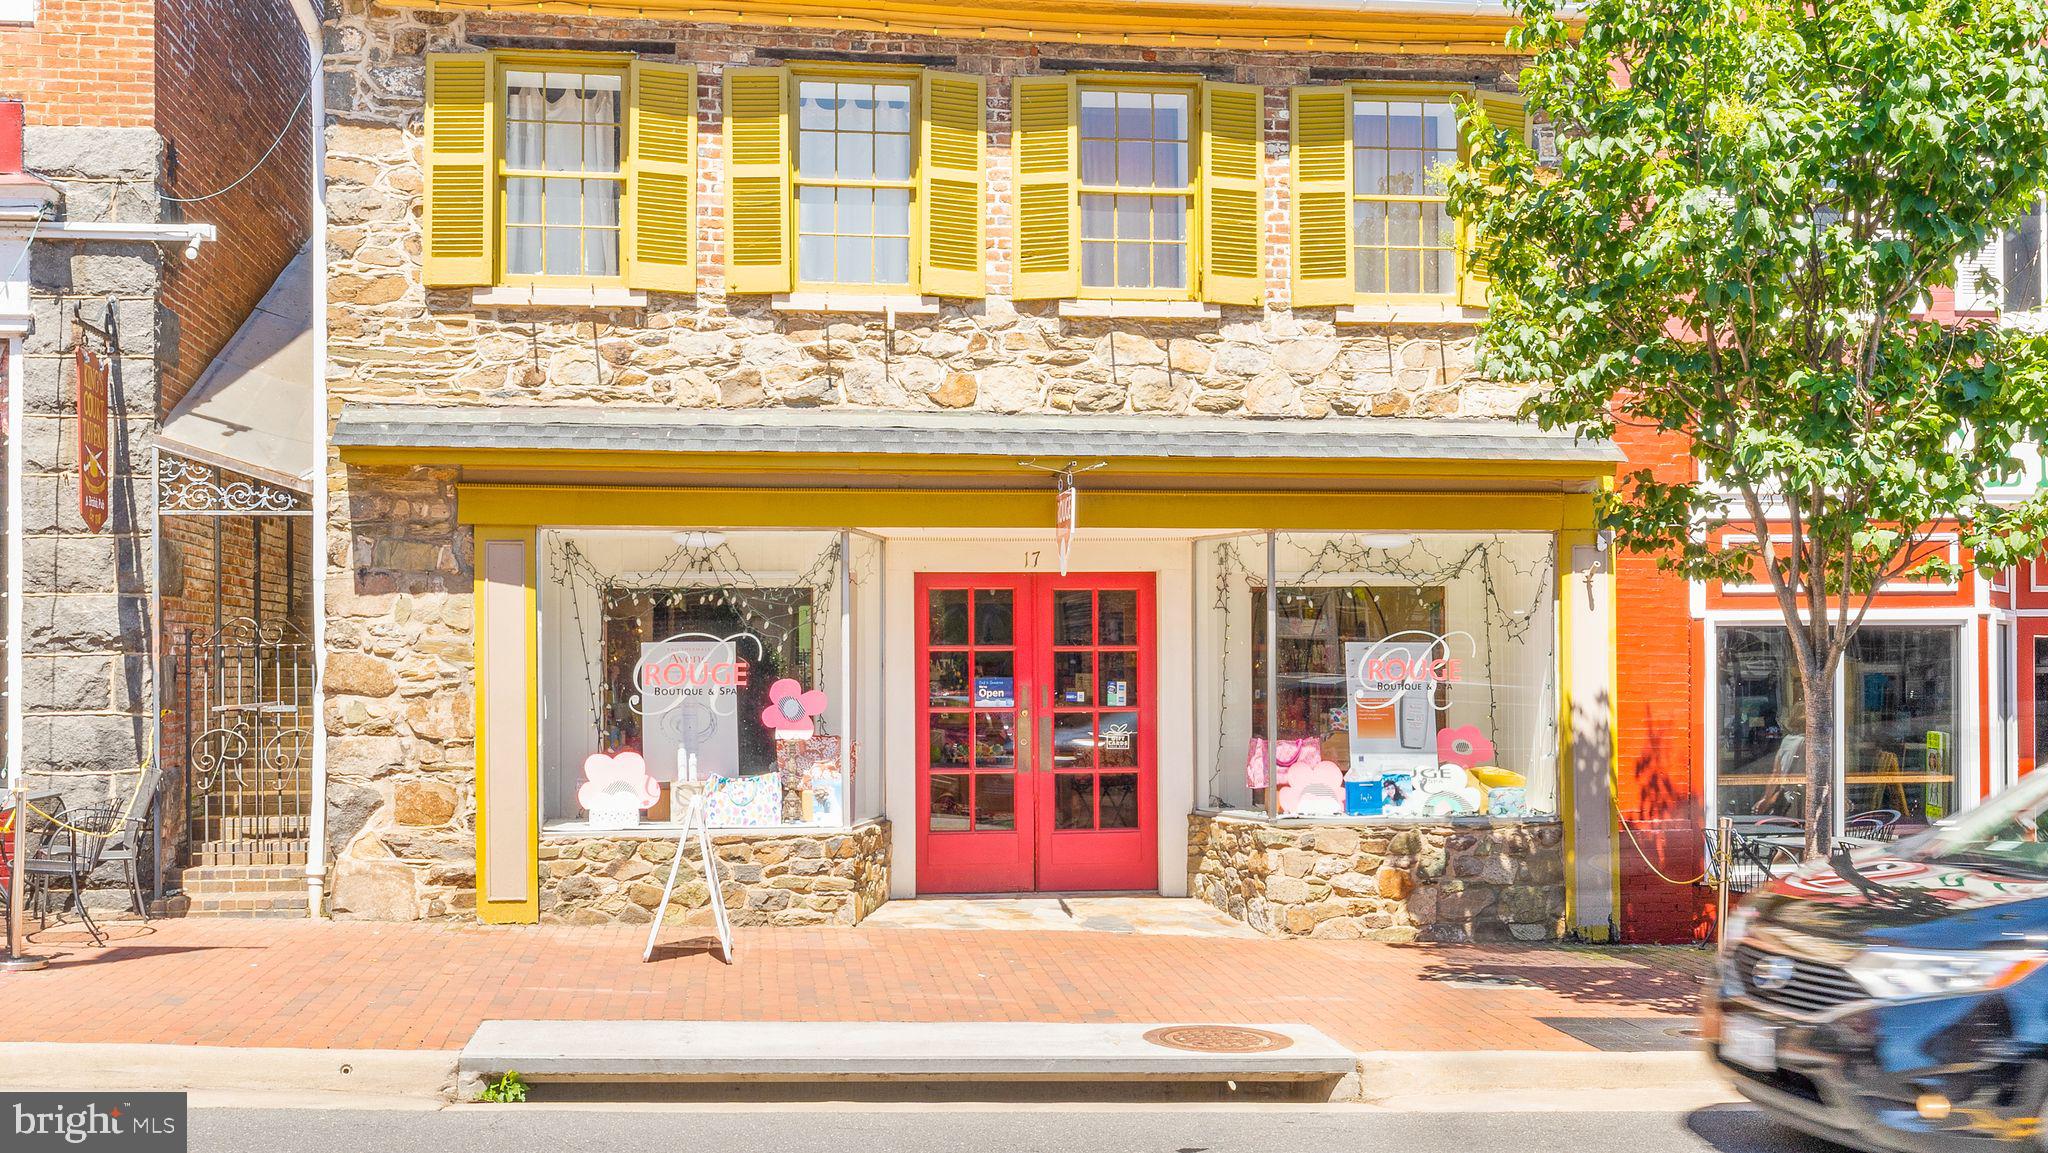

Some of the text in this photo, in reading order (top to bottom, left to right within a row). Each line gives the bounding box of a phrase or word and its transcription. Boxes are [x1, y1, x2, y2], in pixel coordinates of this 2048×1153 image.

[84, 390, 104, 422] COURT
[83, 418, 106, 450] TAVERN
[1024, 551, 1041, 568] 17
[644, 662, 747, 687] ROUGE
[1367, 658, 1463, 682] ROUGE
[979, 688, 1005, 699] Open
